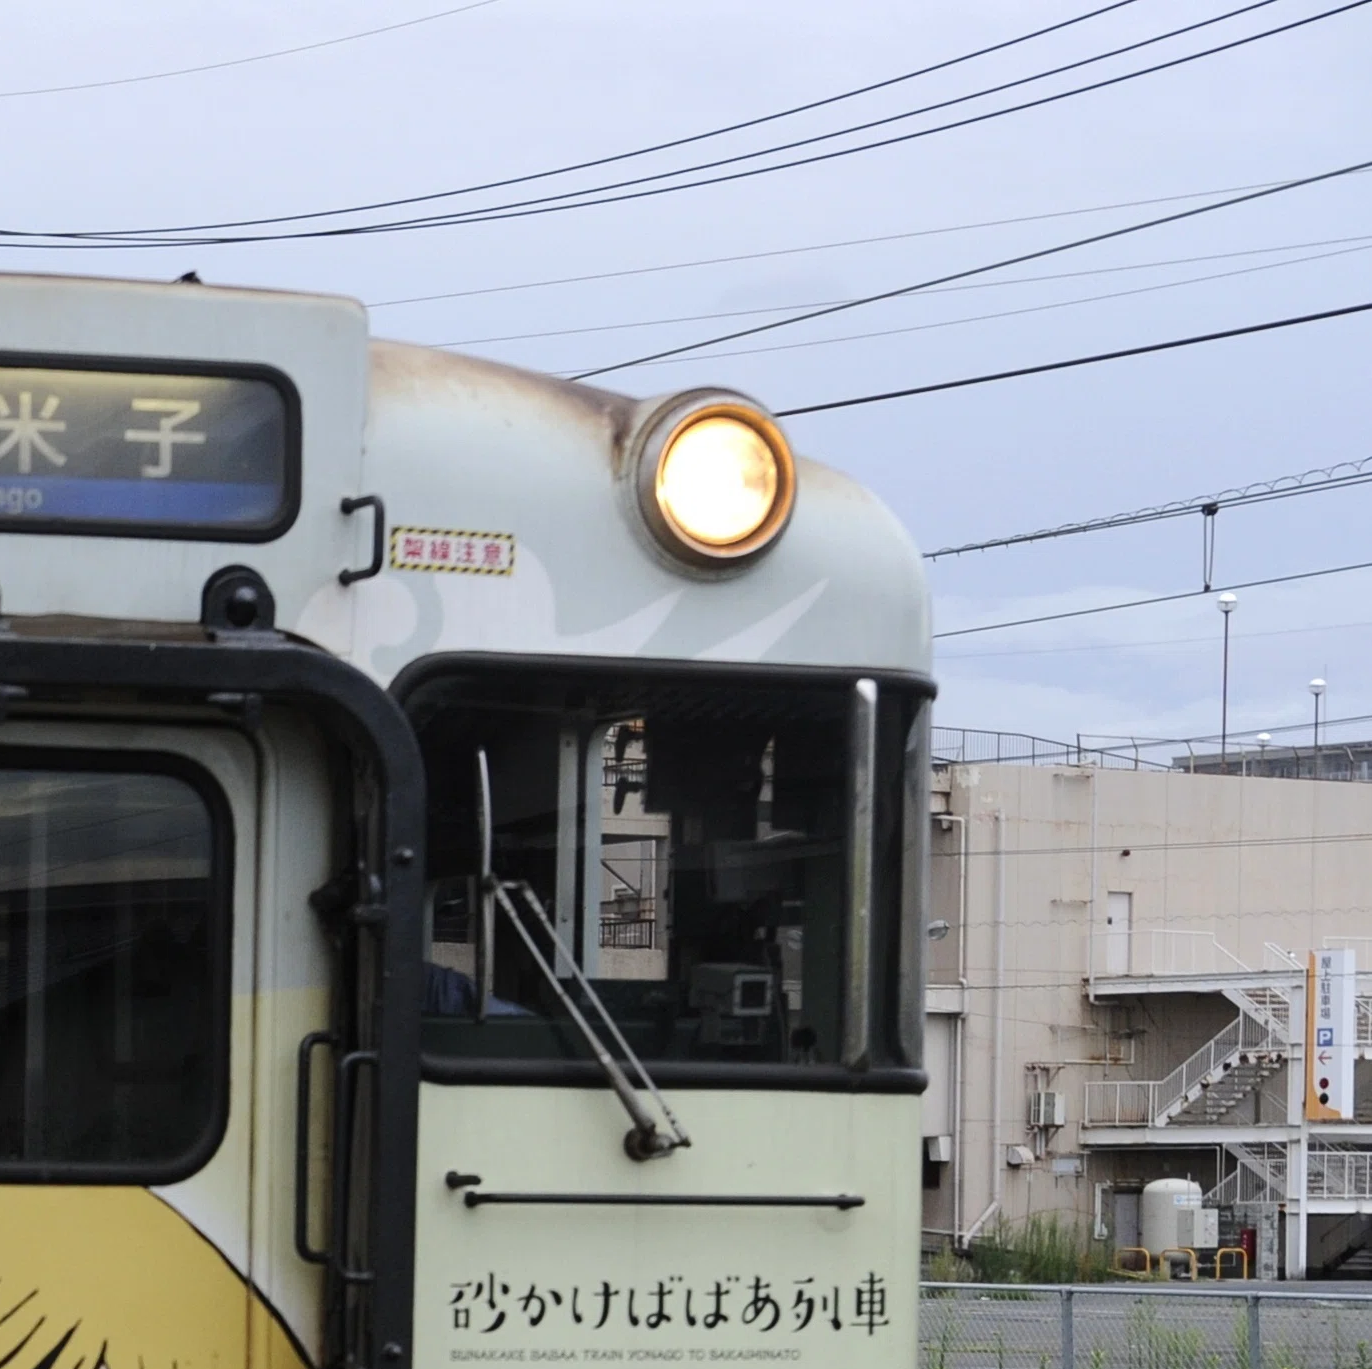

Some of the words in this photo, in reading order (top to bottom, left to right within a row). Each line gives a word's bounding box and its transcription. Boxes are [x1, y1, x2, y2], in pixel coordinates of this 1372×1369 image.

[448, 1271, 890, 1335] 砂かけばばあ列車
[583, 1349, 624, 1362] TRAIN
[627, 1349, 684, 1362] YONAGO
